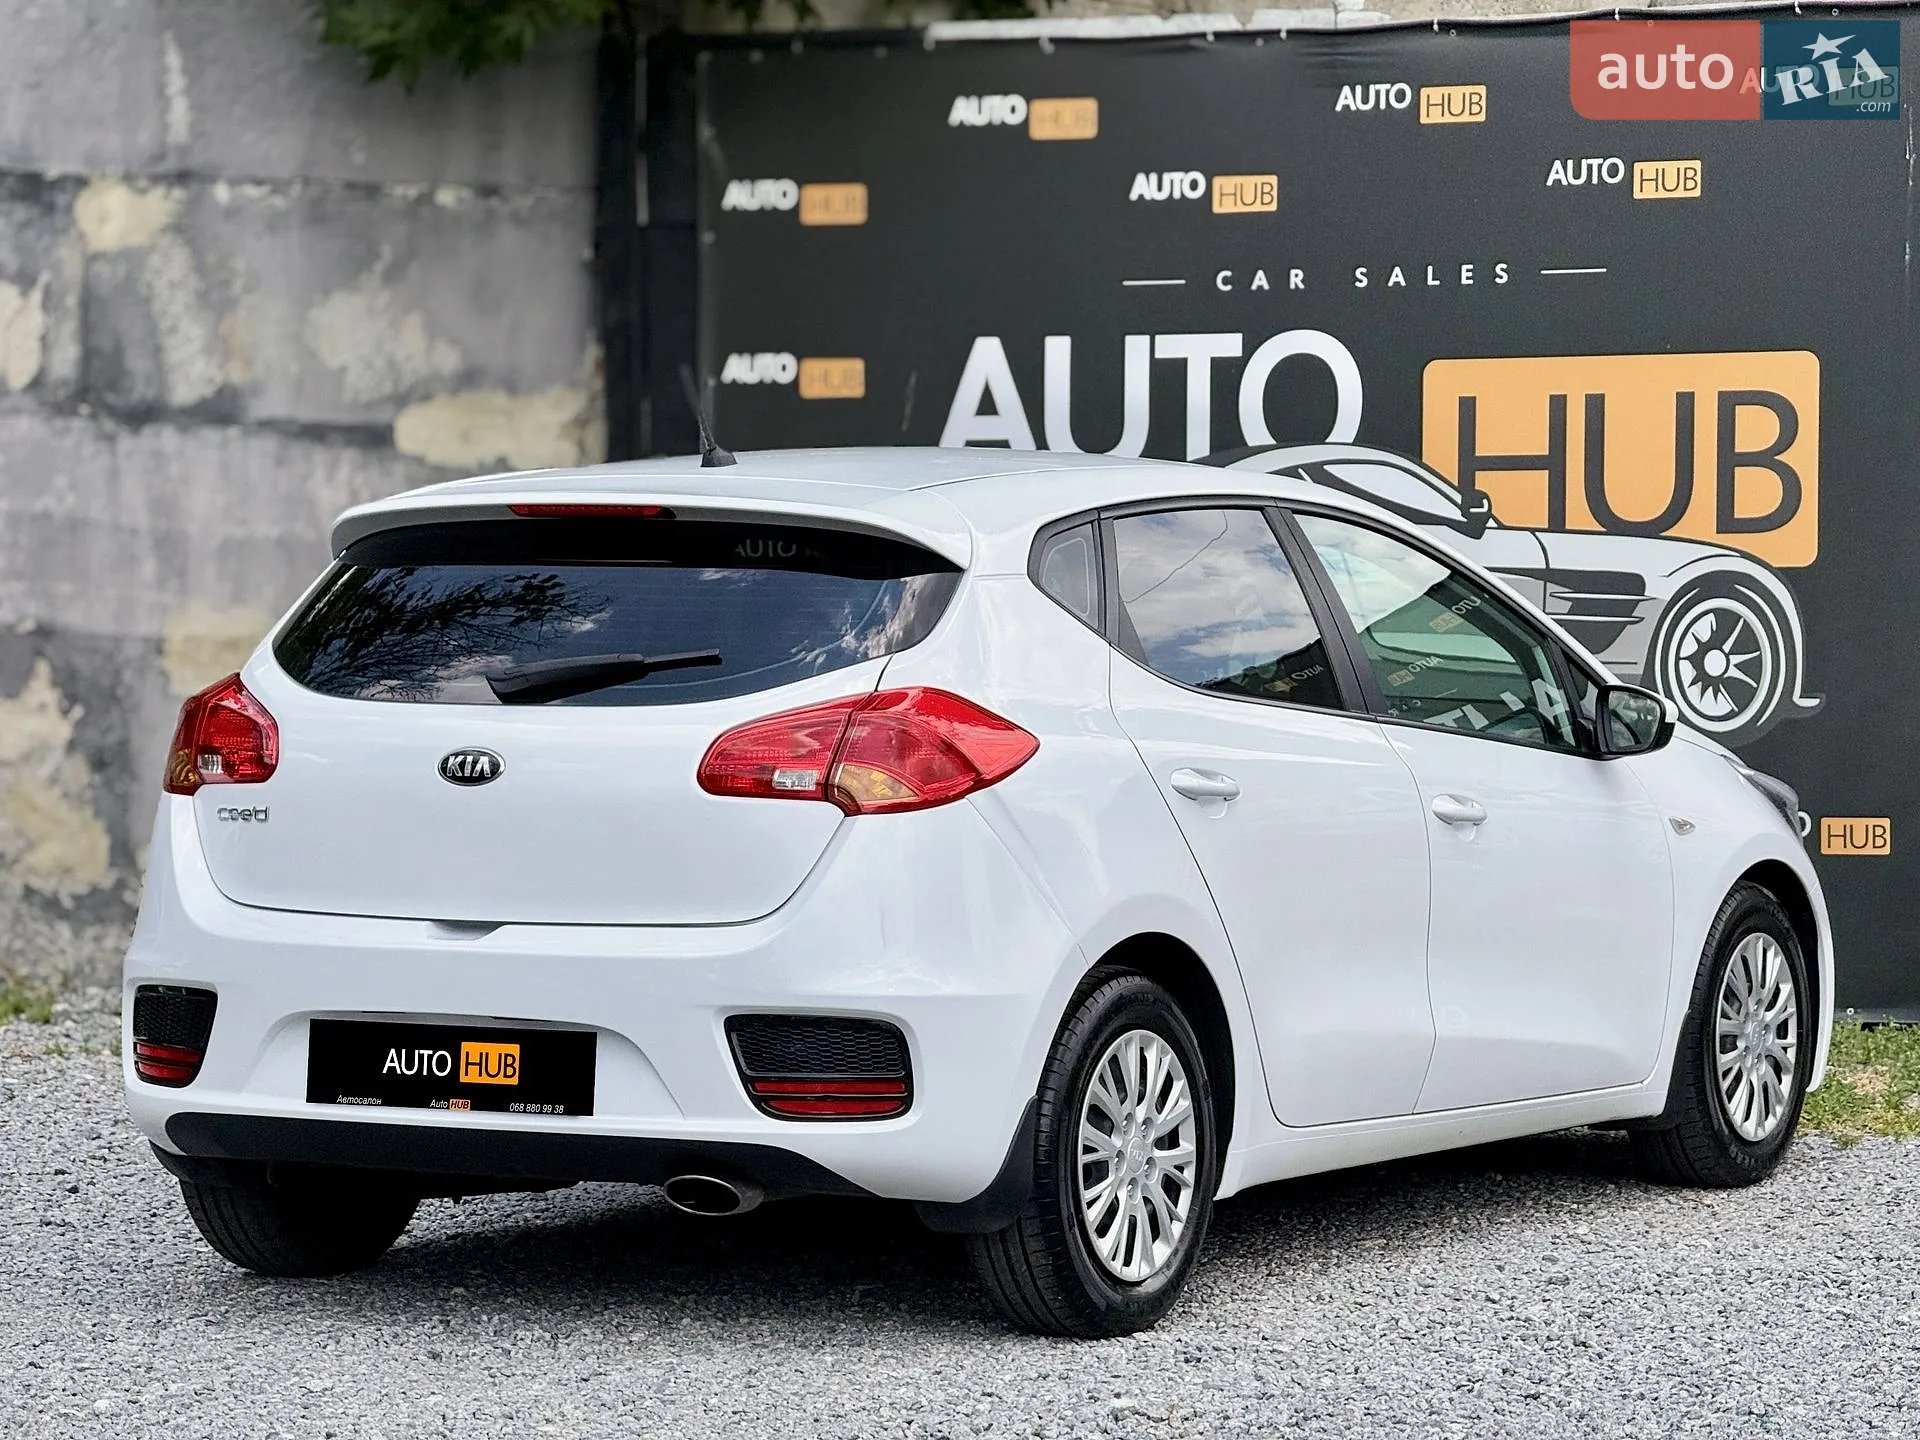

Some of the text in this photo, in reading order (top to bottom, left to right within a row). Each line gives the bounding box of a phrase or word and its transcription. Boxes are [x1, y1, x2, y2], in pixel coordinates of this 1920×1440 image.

[947, 94, 1028, 127] AUTO
[1335, 82, 1483, 118] AUTO HUB
[1129, 171, 1275, 207] AUTO HUB
[1546, 157, 1698, 193] AUTO HUB
[721, 178, 799, 211] AUTO
[1215, 263, 1510, 292] CAR SALES
[720, 352, 798, 385] AUTO
[938, 329, 1803, 536] AUTO HUB
[446, 755, 491, 777] KIA
[1827, 824, 1887, 849] HUB
[382, 1047, 517, 1079] AUTO HUB
[336, 1094, 382, 1105] Автосалон
[430, 1099, 470, 1109] Auto HUB
[509, 1102, 564, 1114] 068 880 99 38
